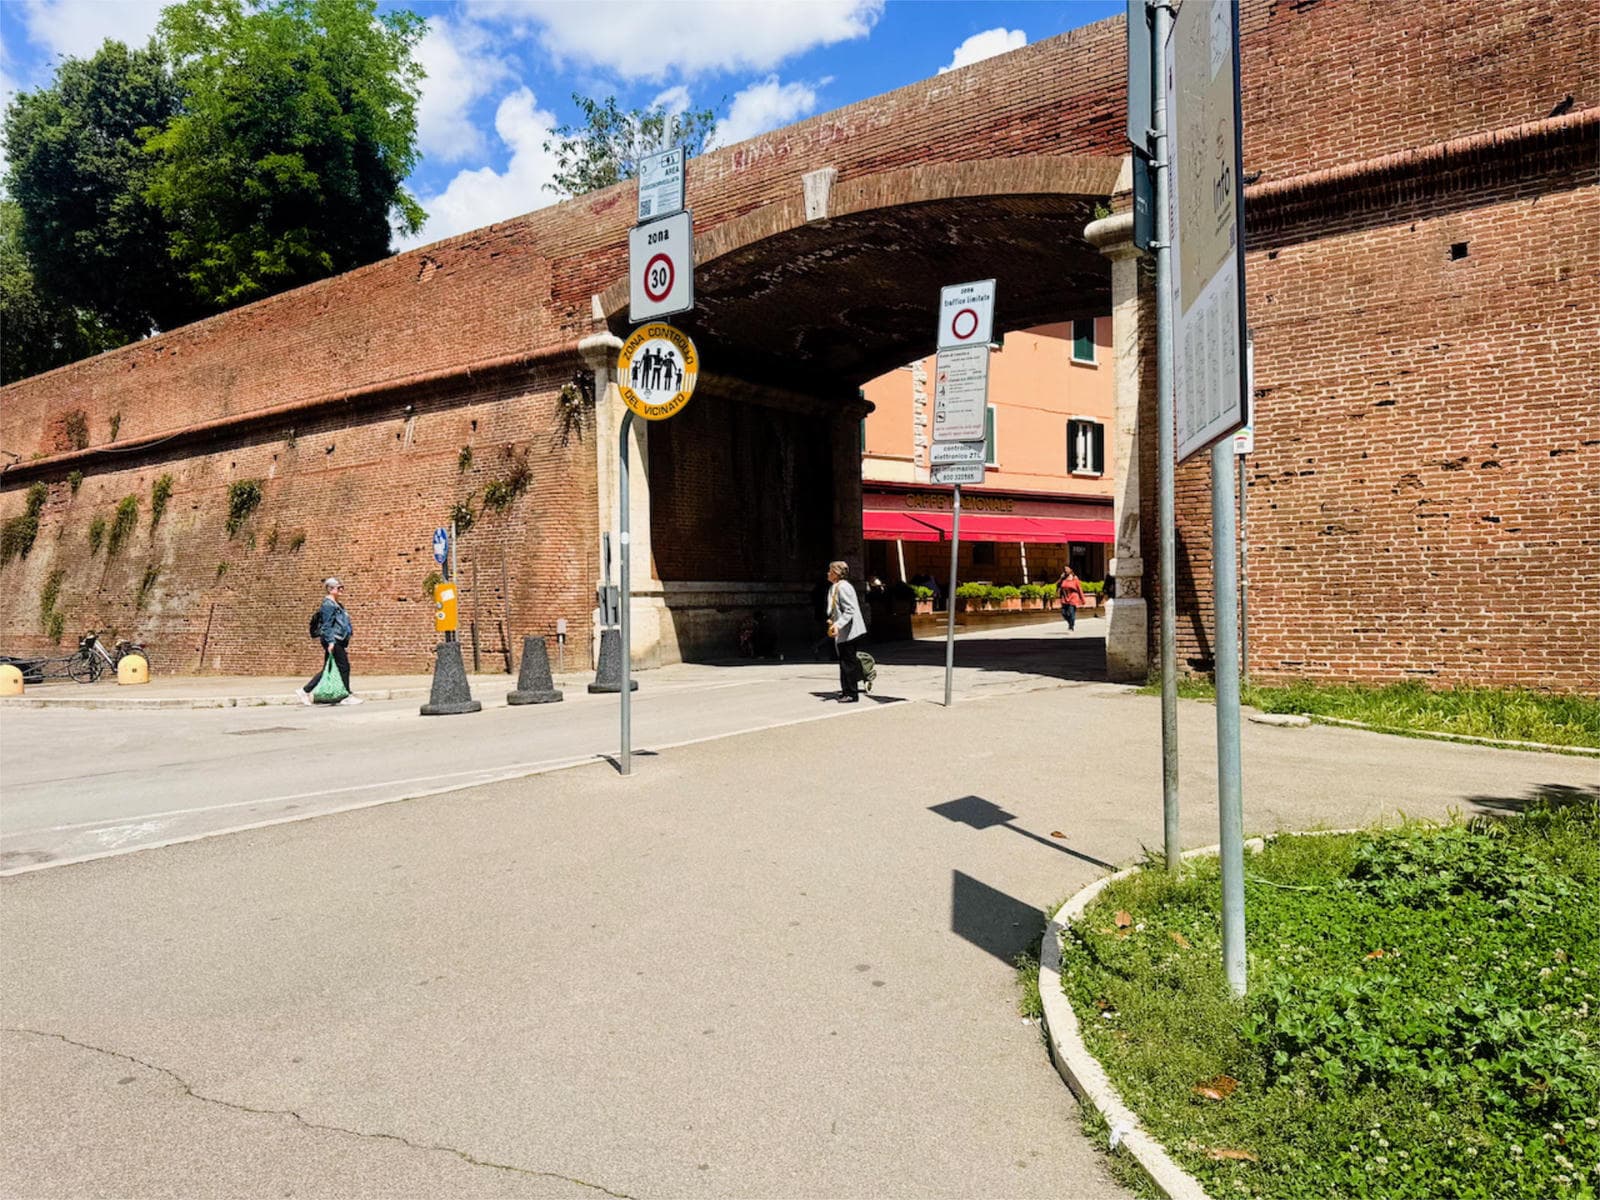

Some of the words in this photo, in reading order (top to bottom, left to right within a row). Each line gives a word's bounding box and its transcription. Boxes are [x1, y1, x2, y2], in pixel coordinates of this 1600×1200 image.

[1213, 160, 1231, 214] Info
[648, 229, 670, 245] zona
[651, 267, 667, 289] 30
[623, 334, 645, 361] ZONA
[648, 327, 694, 365] CONTROLLO
[624, 389, 641, 410] DEL
[644, 393, 685, 416] VICINATO
